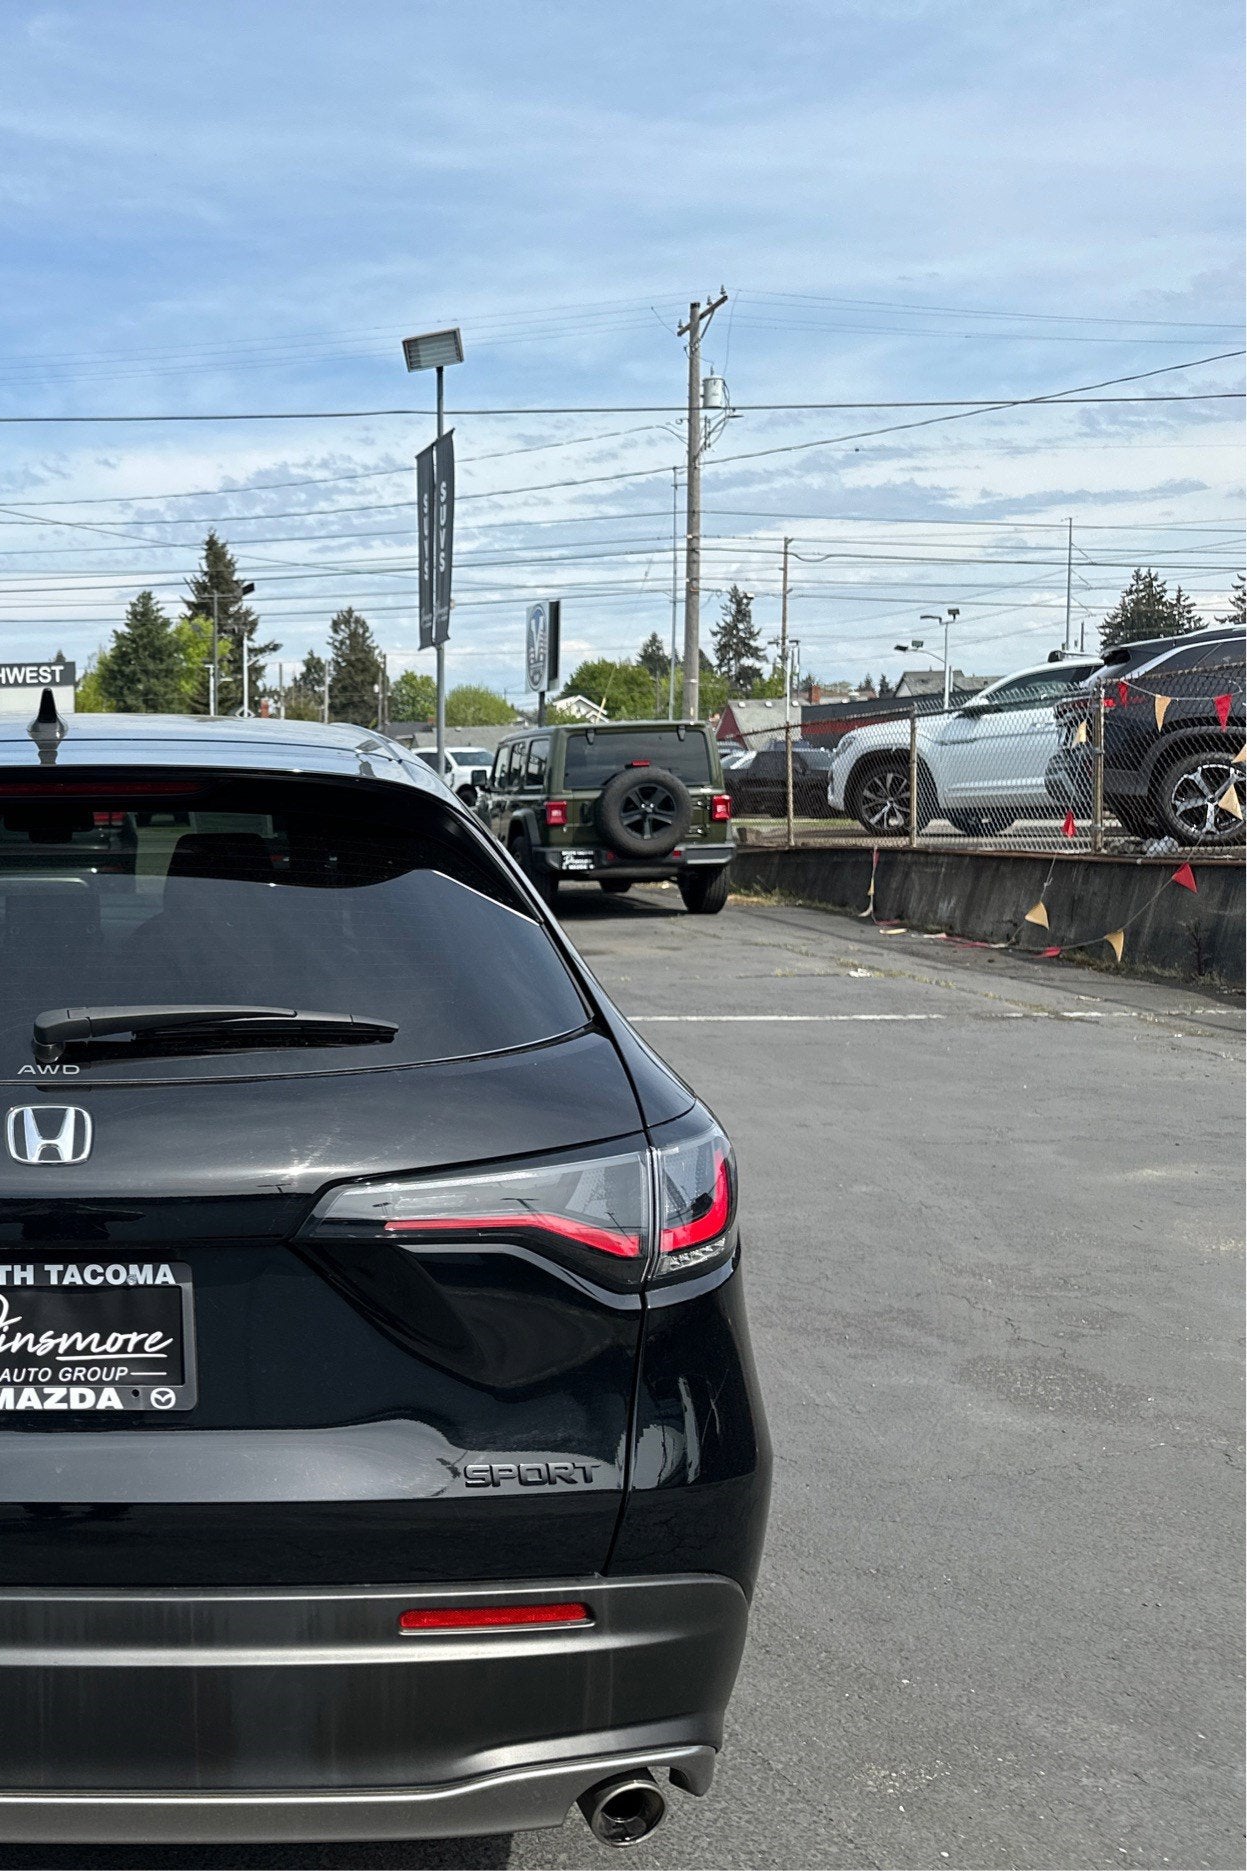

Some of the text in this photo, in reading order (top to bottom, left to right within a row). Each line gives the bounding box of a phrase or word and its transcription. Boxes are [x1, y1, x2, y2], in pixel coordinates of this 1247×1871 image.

[439, 481, 447, 572] SUVS
[17, 1064, 81, 1075] AWD
[44, 1263, 176, 1286] TACOMA
[58, 1366, 129, 1382] GROUP
[464, 1462, 601, 1488] SPORT
